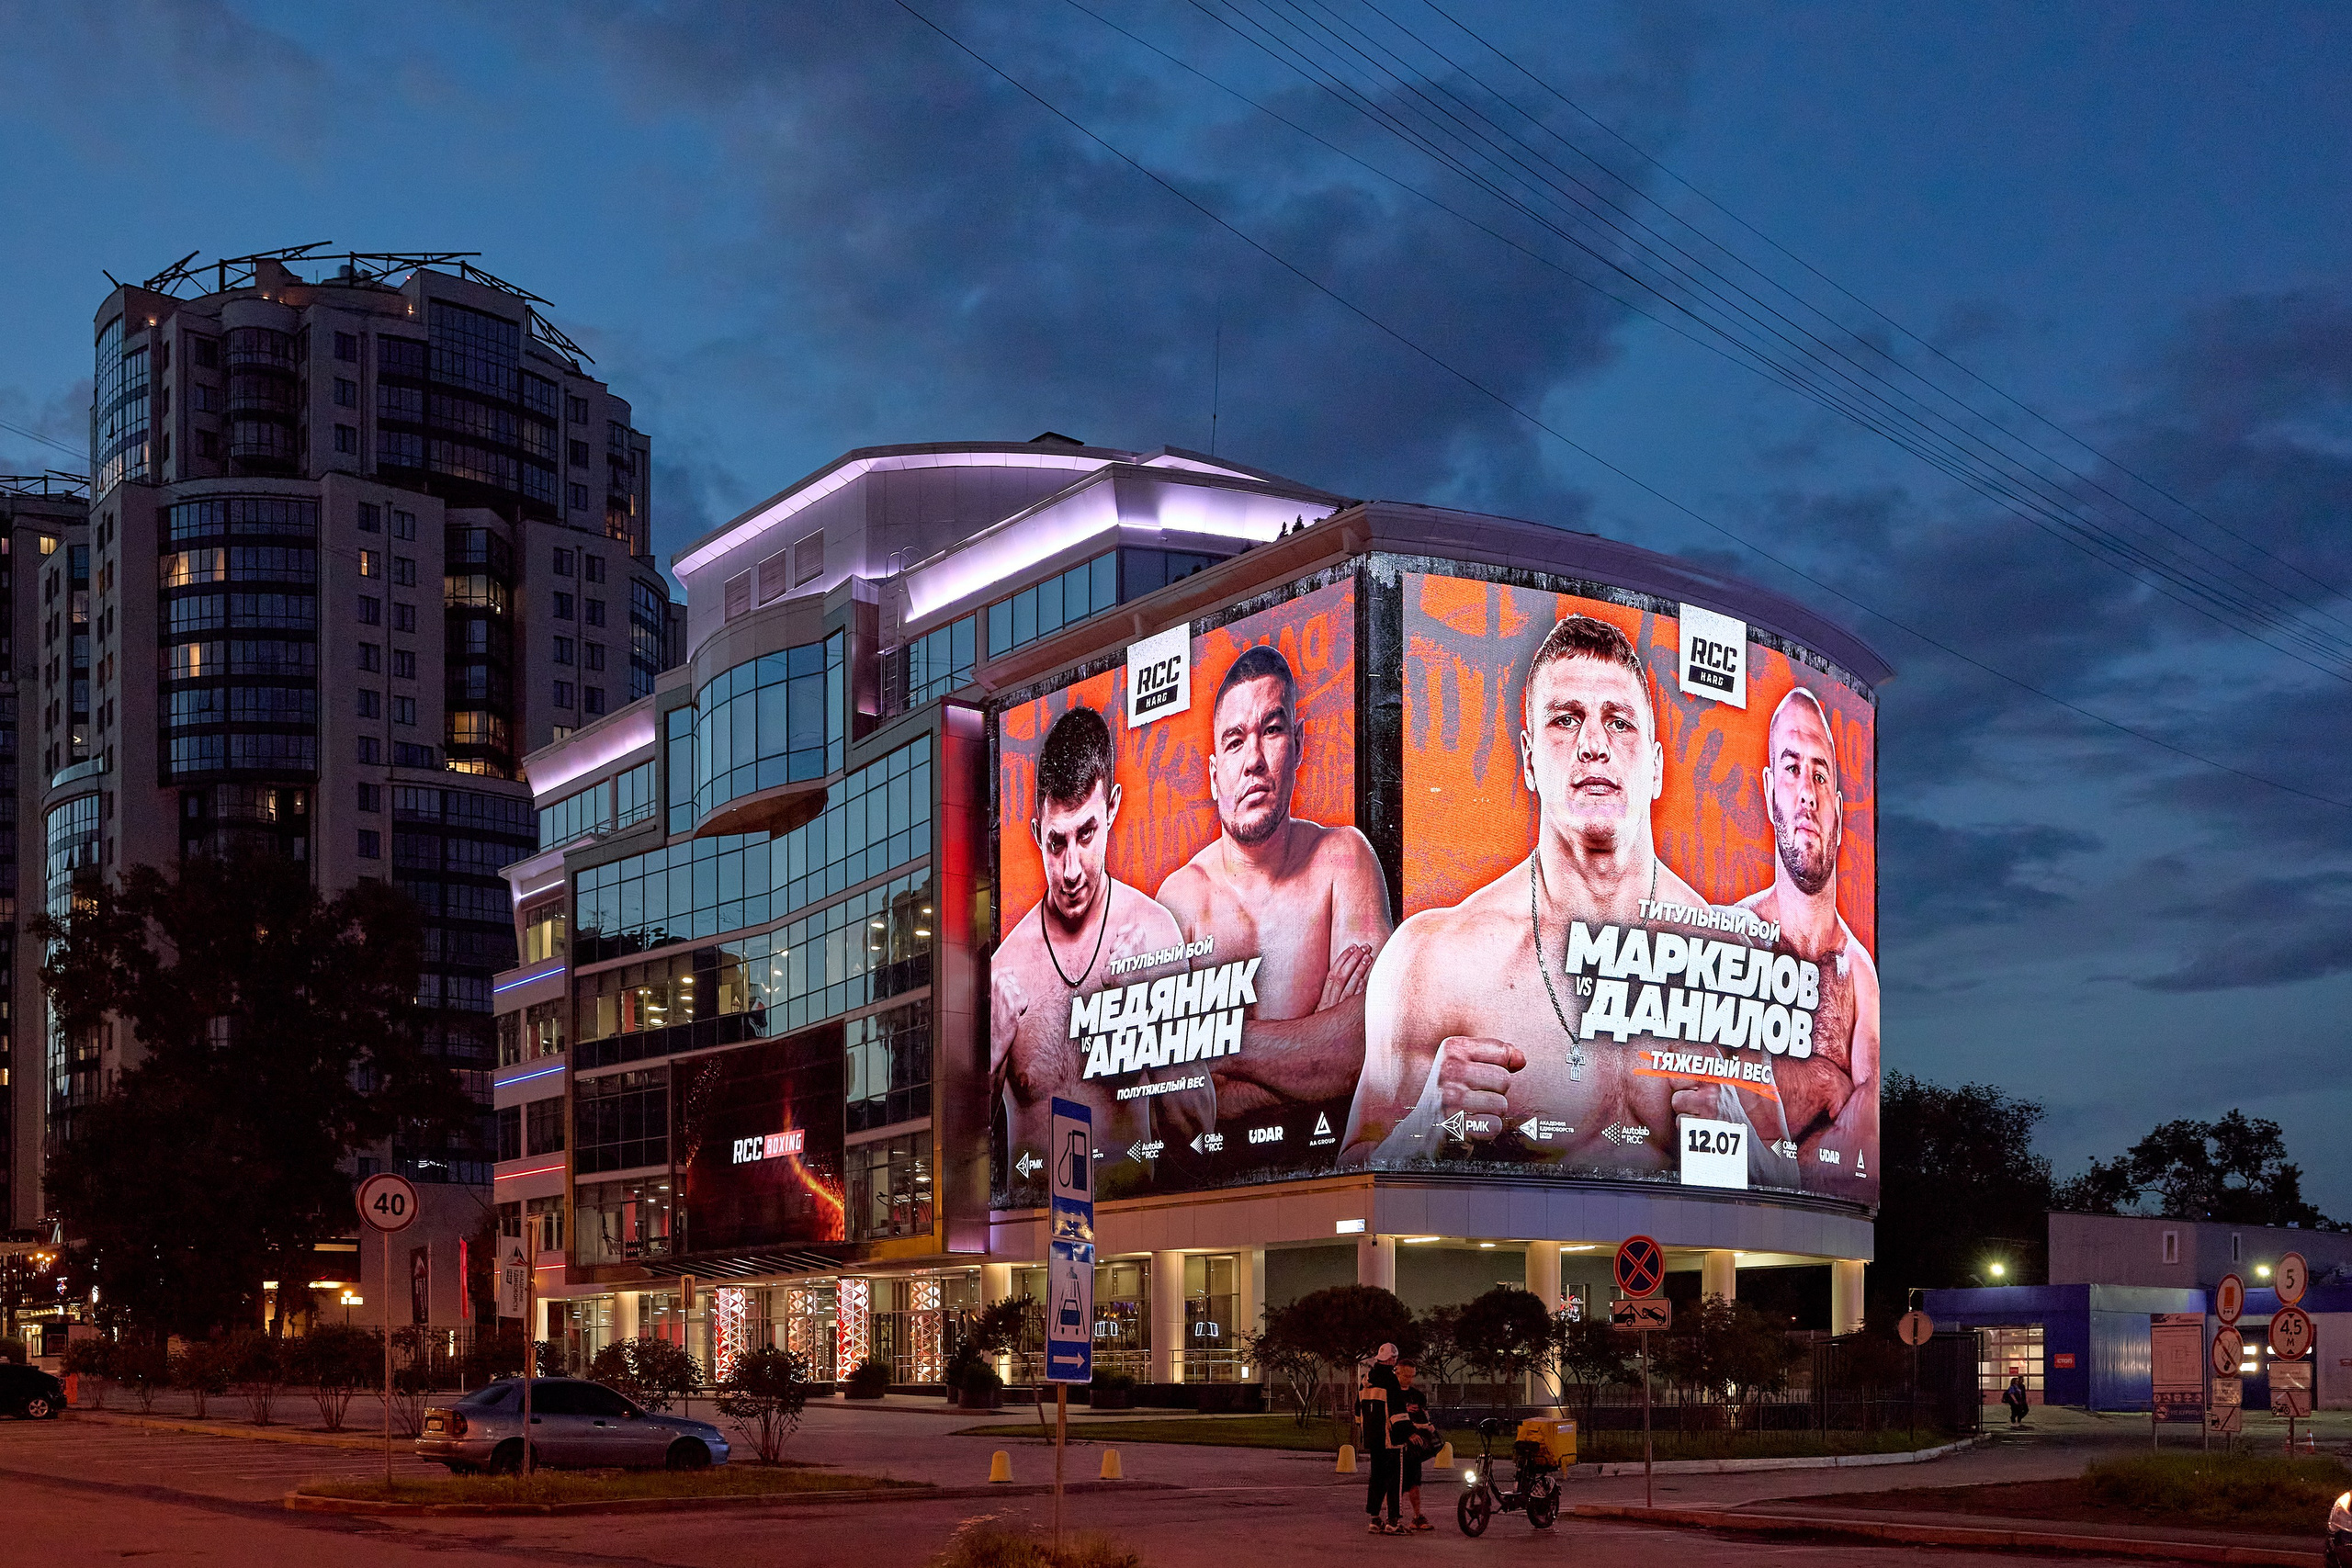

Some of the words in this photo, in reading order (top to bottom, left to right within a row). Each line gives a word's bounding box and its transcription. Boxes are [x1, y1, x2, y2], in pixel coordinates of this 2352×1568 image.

[1690, 636, 1738, 673] RCC
[1136, 655, 1182, 695] RCC
[1700, 671, 1724, 687] HARD
[1145, 692, 1168, 708] HARD
[1637, 897, 1747, 935] ТИТУЛЬНЫЙ
[1747, 919, 1781, 942] БОЙ
[1110, 941, 1186, 976] ТИТУЛЬНЫЙ
[1185, 934, 1215, 957] БОЙ
[1565, 920, 1821, 1010] МАРКЕЛОВ
[1069, 956, 1263, 1039] МЕДЯНИК
[1576, 976, 1593, 997] VS
[1579, 978, 1815, 1059] ДАНИЛОВ
[1082, 1008, 1245, 1079] АНАНИН
[1650, 1050, 1741, 1080] ТЯЖЕЛЫЙ
[1743, 1062, 1772, 1085] ВЕС
[1116, 1077, 1187, 1100] ПОЛУТЯЖЕЛЫЙ
[1186, 1076, 1205, 1089] ВЕС
[1249, 1126, 1284, 1145] UDAR
[1317, 1137, 1337, 1145] GROUP
[1622, 1125, 1650, 1136] Autolab
[1626, 1134, 1644, 1145] RCC
[1688, 1129, 1741, 1156] 12.07
[732, 1135, 763, 1165] RCC
[766, 1133, 803, 1155] BOXING
[1141, 1139, 1165, 1151] Autolab
[1145, 1149, 1159, 1159] RCC
[1208, 1142, 1224, 1152] RCC
[1818, 1148, 1840, 1165] UDAR
[373, 1192, 405, 1216] 40
[2286, 1269, 2295, 1290] 5
